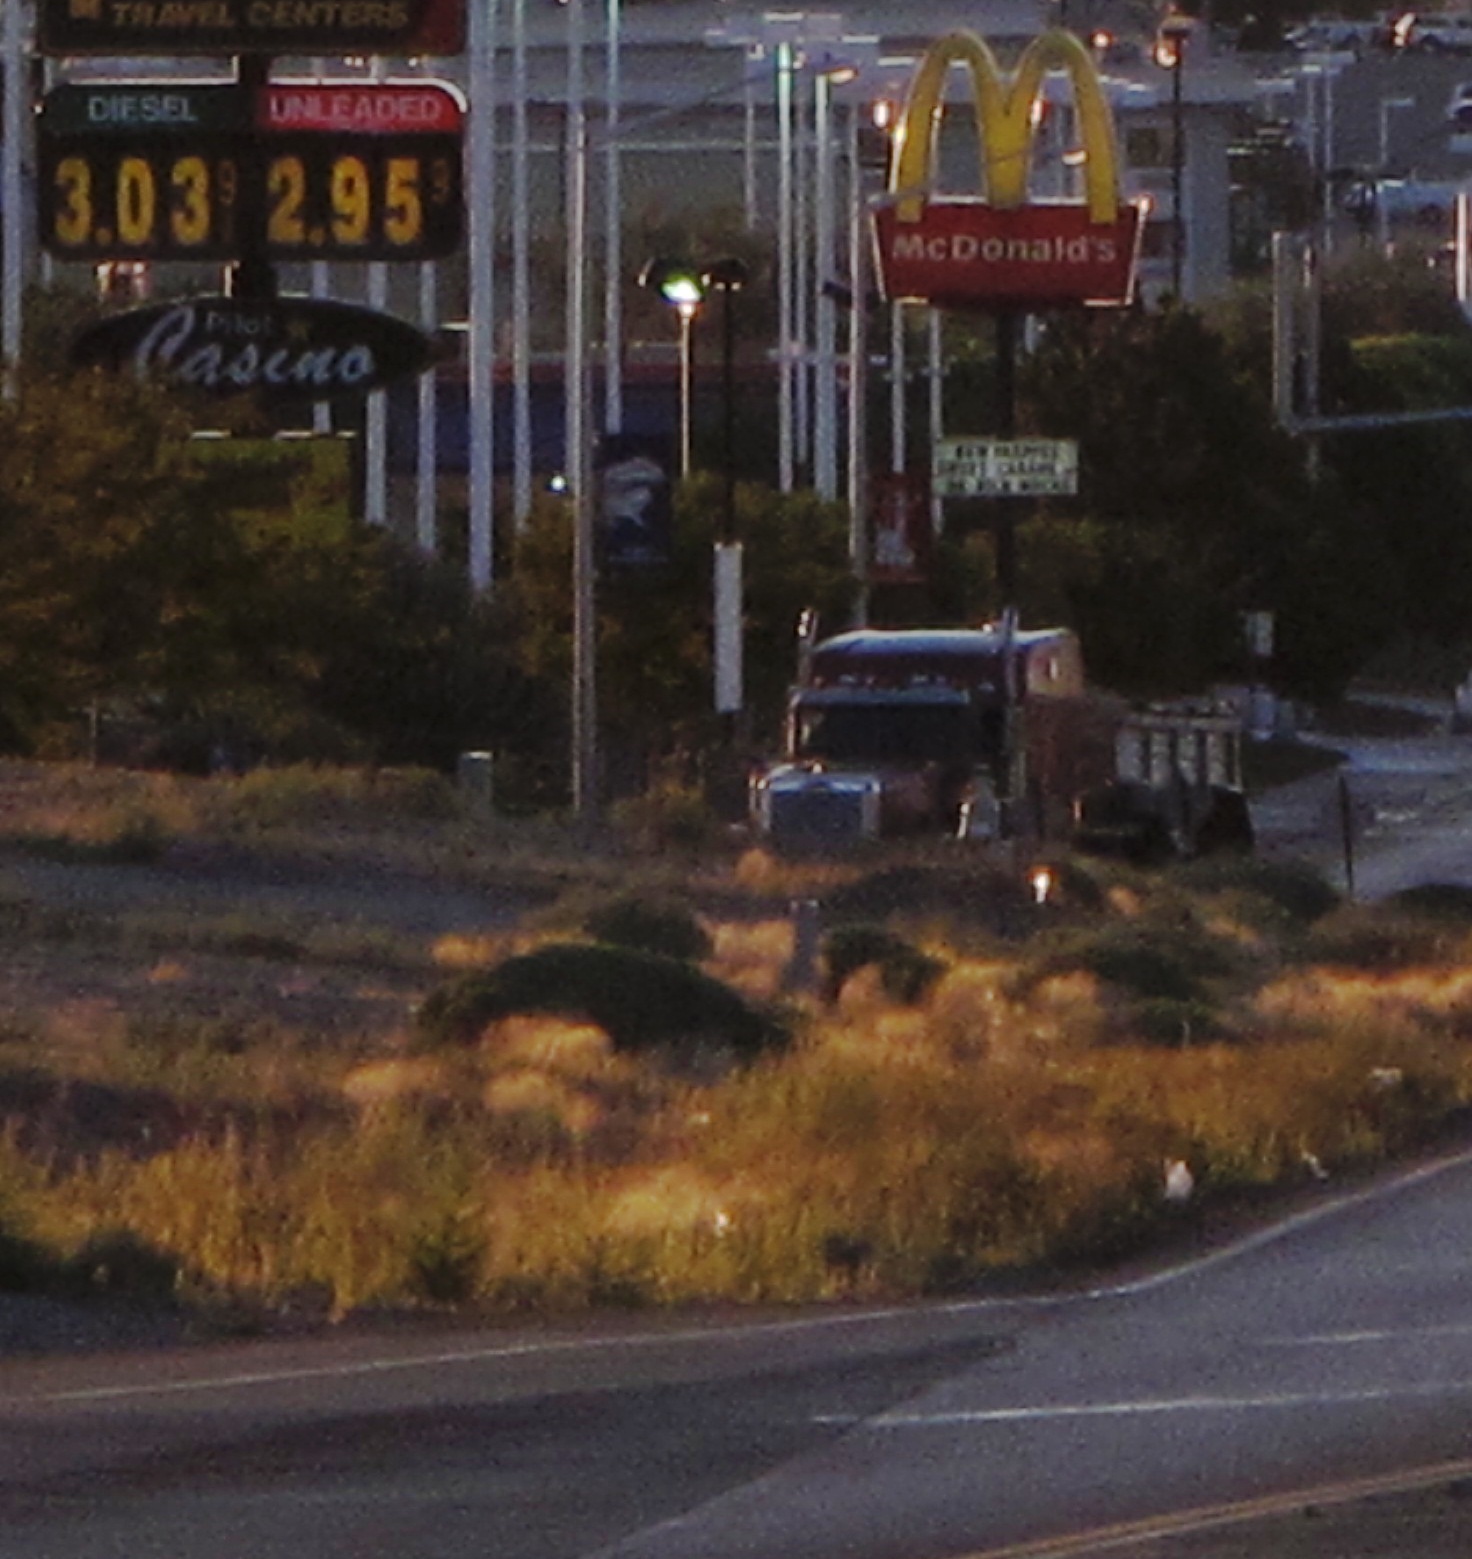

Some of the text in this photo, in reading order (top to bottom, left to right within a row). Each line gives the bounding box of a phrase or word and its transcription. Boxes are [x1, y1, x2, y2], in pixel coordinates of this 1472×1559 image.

[247, 1, 409, 29] CENTERS
[88, 95, 198, 124] DIESEL
[270, 94, 442, 124] UNLEADED
[892, 234, 1118, 263] McDonald's
